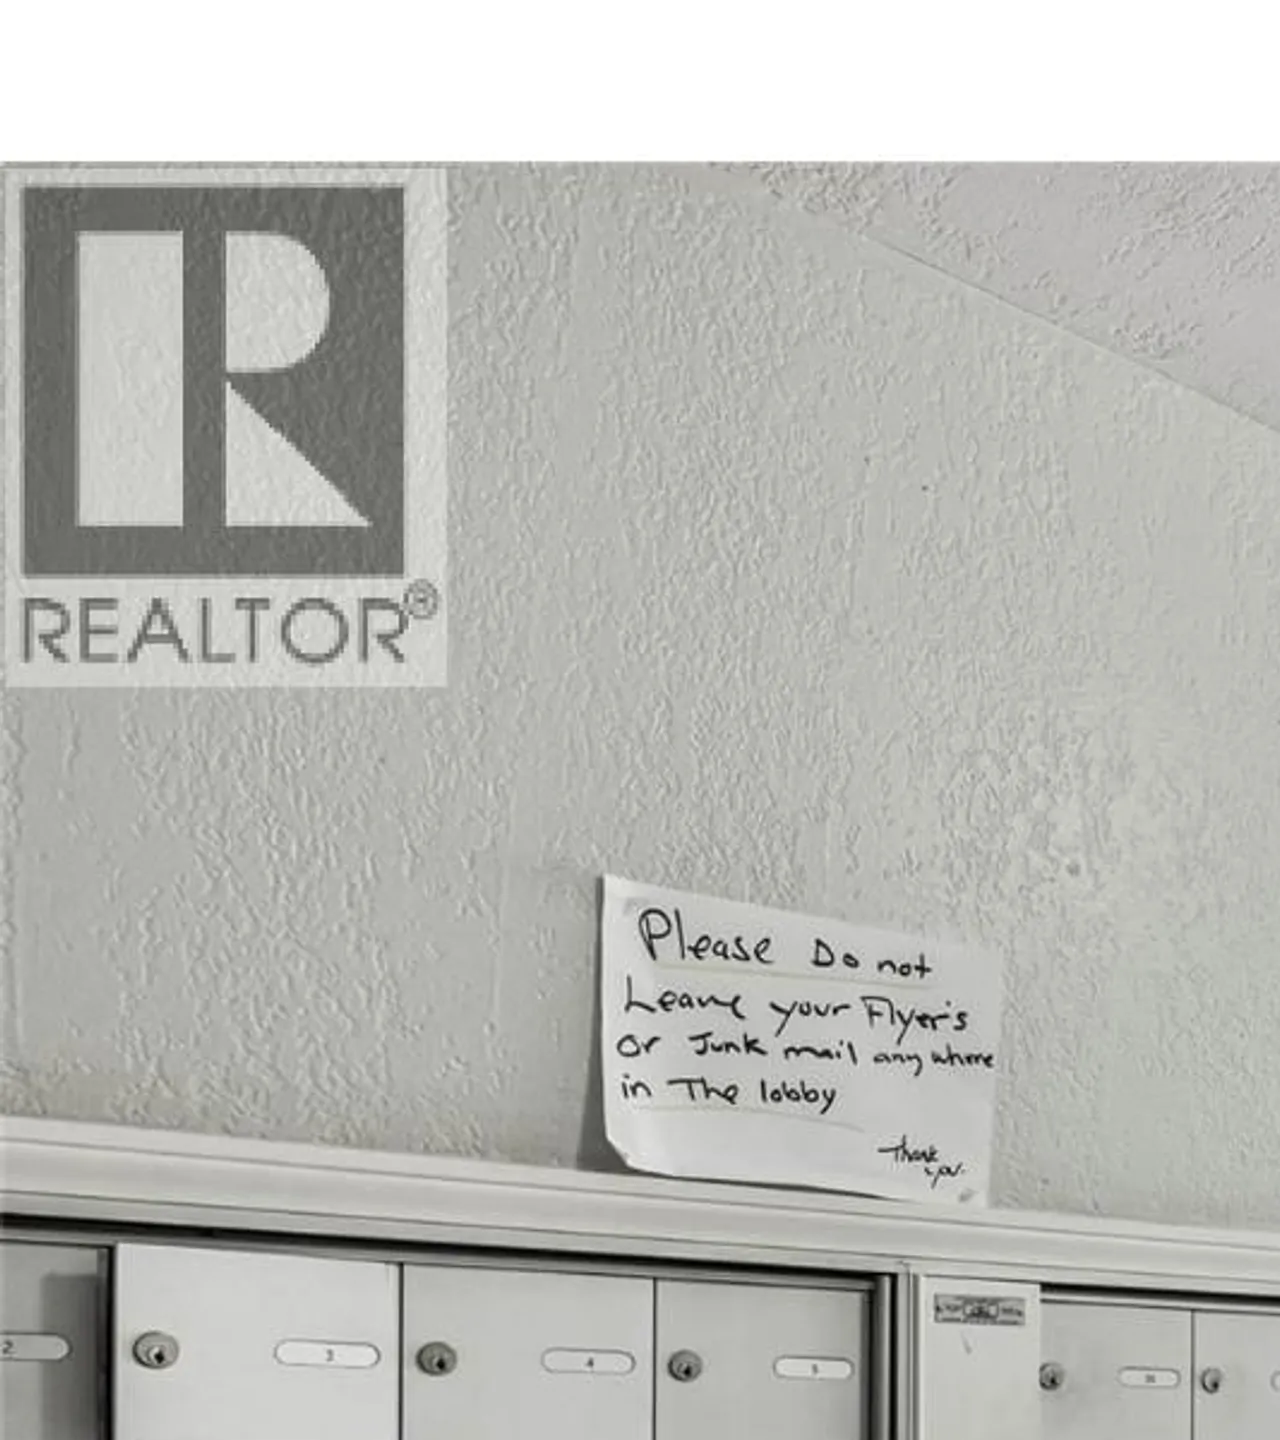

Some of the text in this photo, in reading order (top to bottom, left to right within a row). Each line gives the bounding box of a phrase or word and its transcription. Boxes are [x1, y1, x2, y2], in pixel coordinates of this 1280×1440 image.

[637, 907, 932, 979] Please Do not
[625, 974, 747, 1019] Leave
[769, 998, 851, 1037] your
[616, 1034, 661, 1058] Or
[689, 1031, 767, 1056] Junk
[783, 1042, 858, 1066] mail
[621, 1074, 838, 1115] in The lobby
[877, 1134, 939, 1163] Thank
